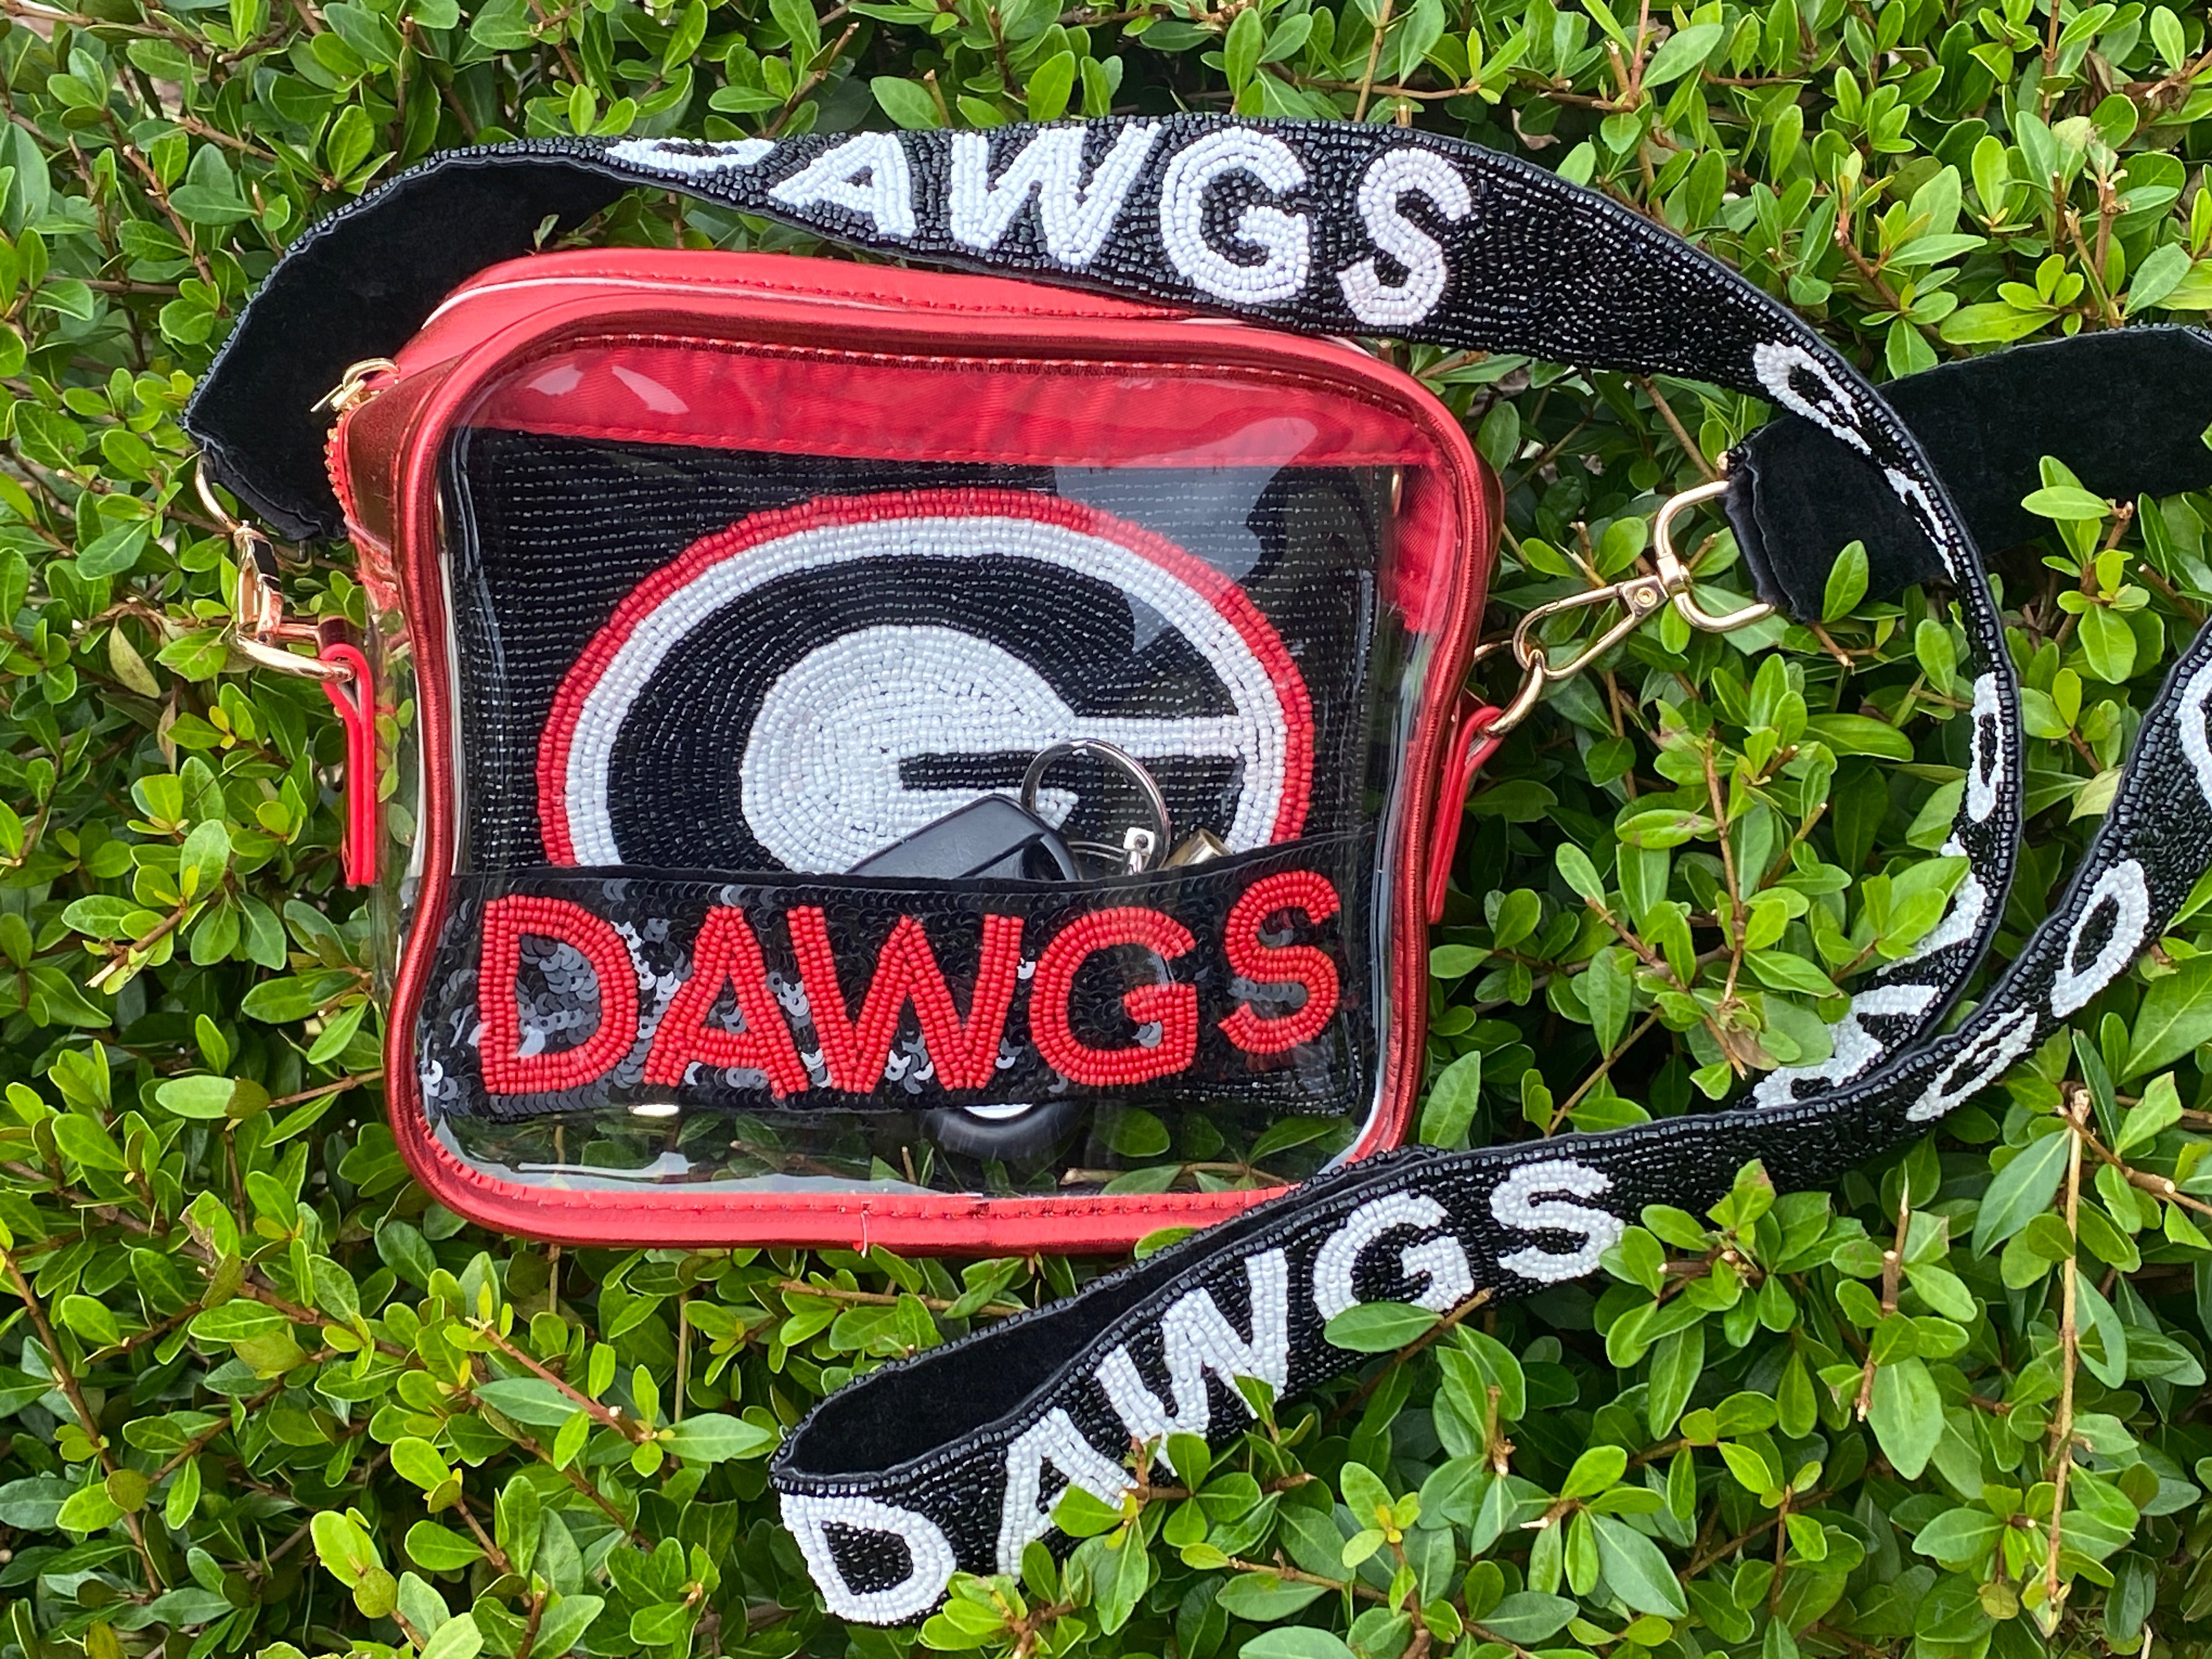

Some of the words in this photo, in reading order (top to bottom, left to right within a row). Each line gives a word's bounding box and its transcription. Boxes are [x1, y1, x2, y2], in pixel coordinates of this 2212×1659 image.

[604, 122, 1472, 326] DAWGS
[539, 487, 1314, 869] G
[478, 869, 1341, 1099] DAWGS
[780, 1159, 1625, 1627] DAWGS
